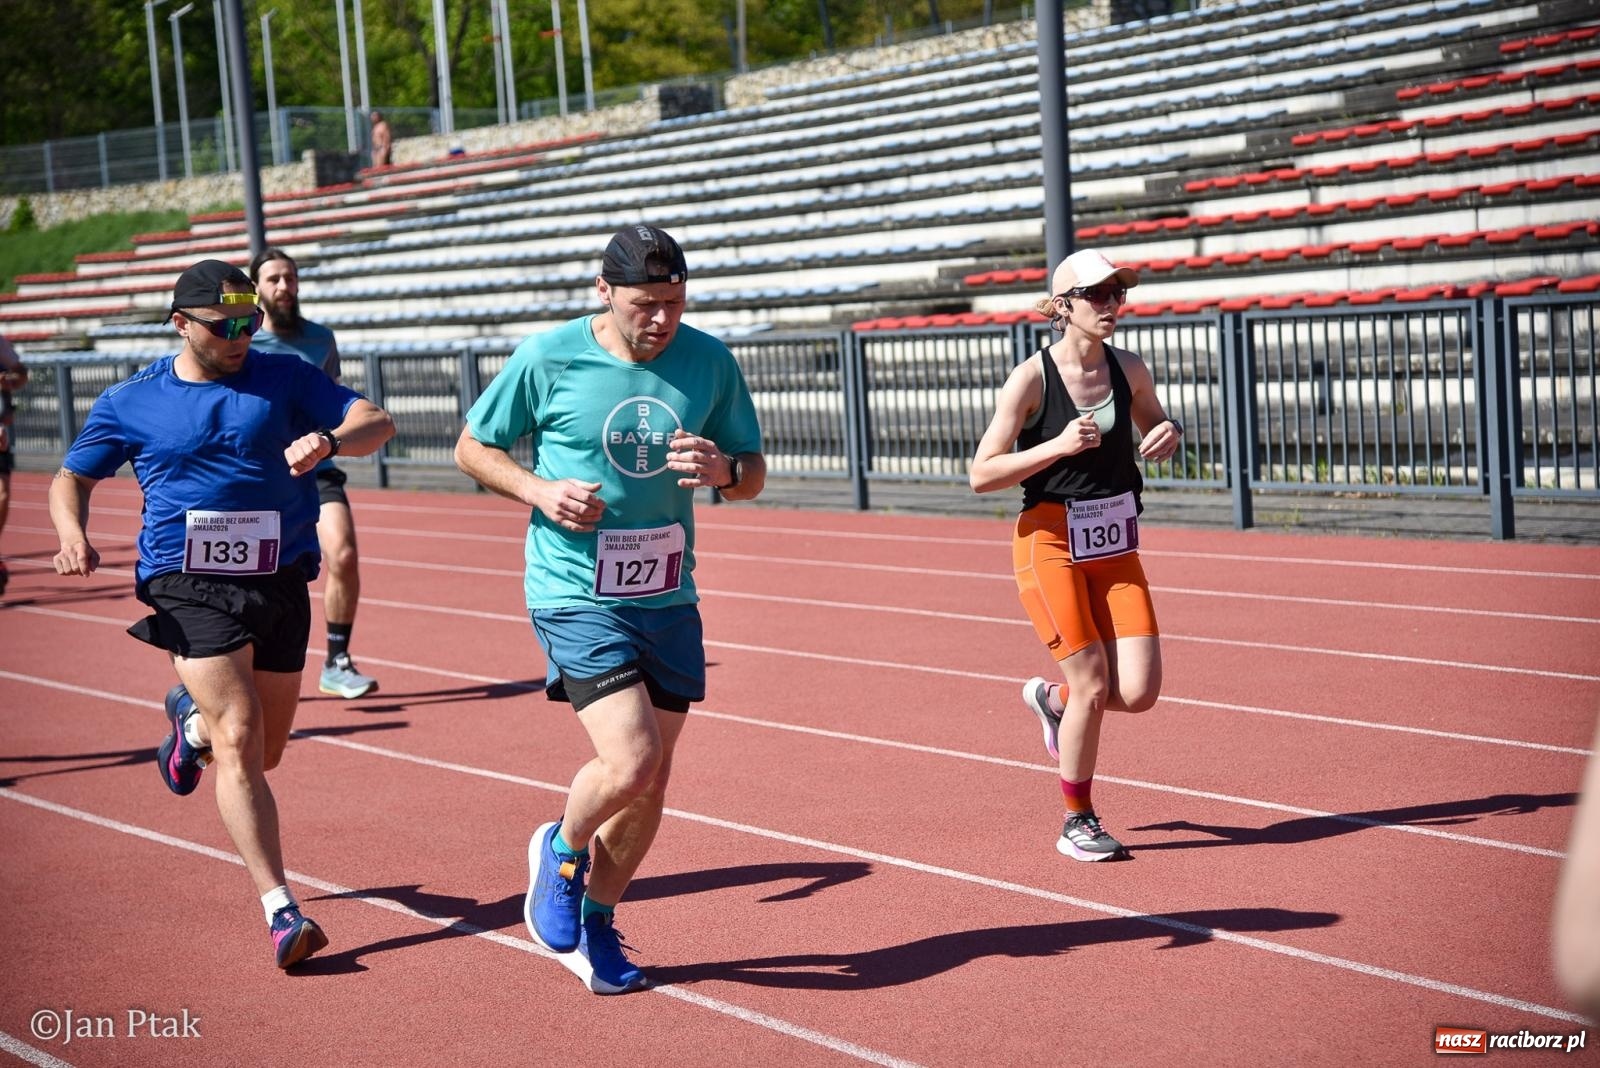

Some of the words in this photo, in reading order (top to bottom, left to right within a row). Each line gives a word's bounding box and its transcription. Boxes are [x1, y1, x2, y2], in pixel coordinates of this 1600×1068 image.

[637, 403, 651, 471] BAYER
[605, 535, 621, 543] XVIII
[622, 535, 637, 543] BIEG
[638, 534, 650, 542] BEZ
[605, 543, 641, 551] 3MAJA2026
[1082, 523, 1120, 549] 130
[202, 541, 249, 565] 133
[615, 558, 659, 586] 127
